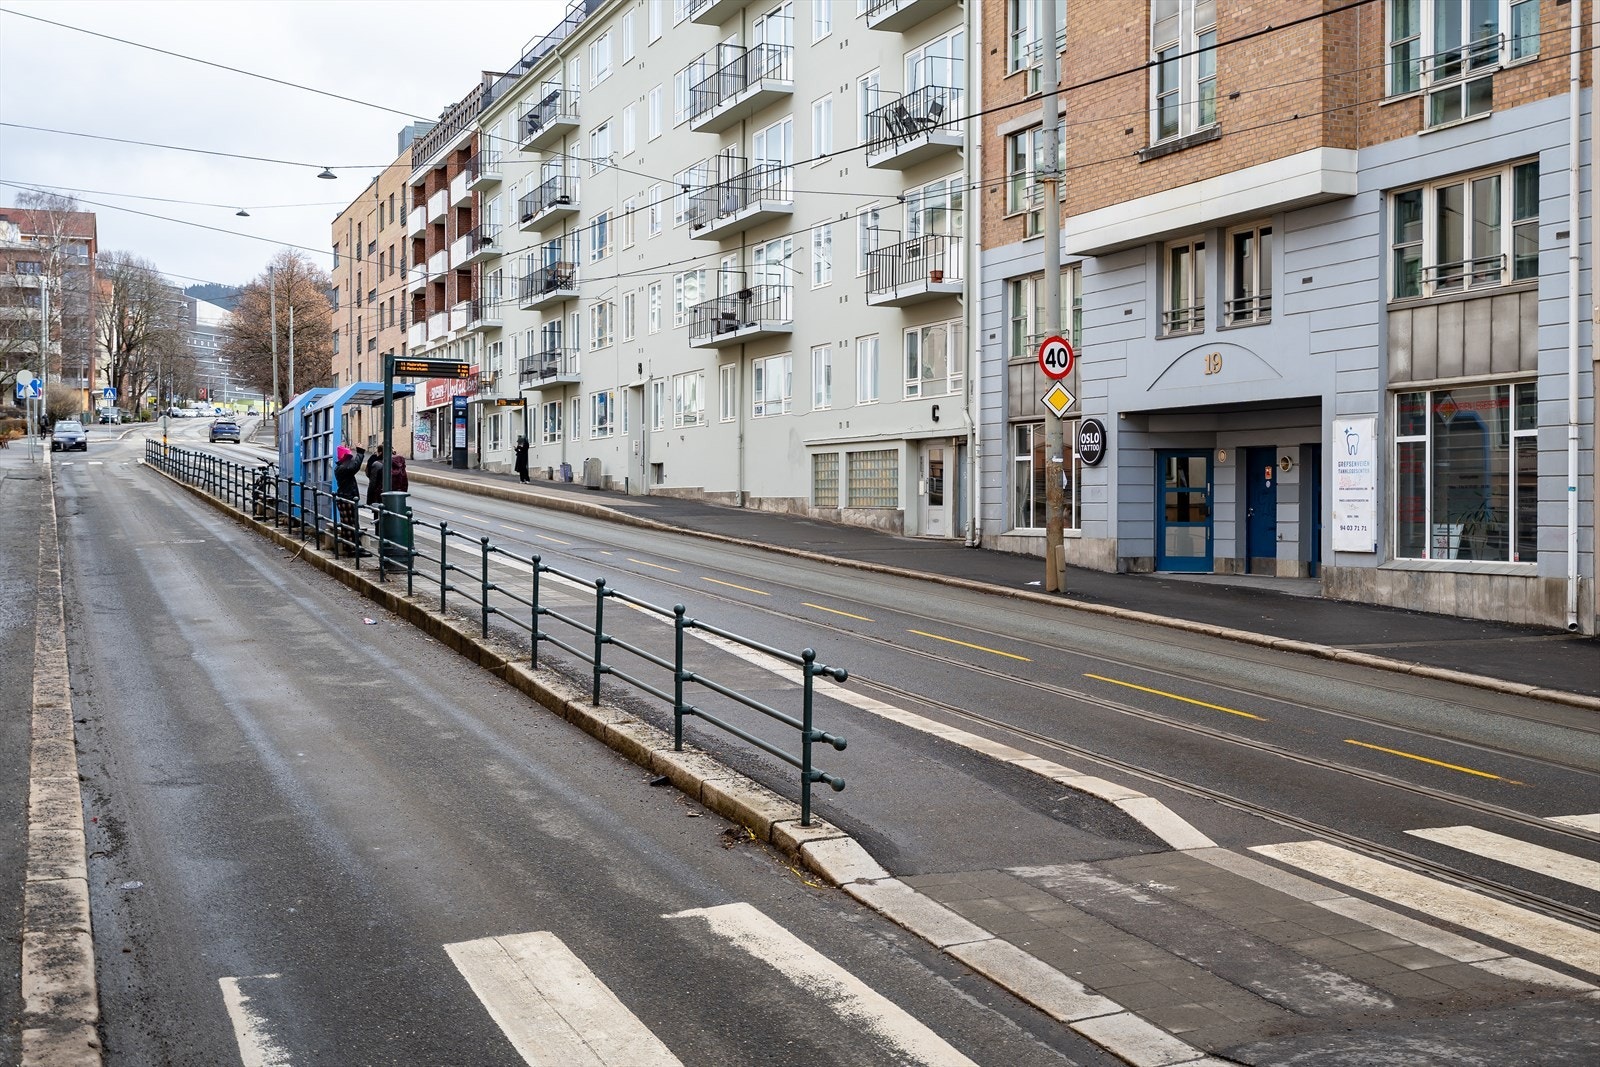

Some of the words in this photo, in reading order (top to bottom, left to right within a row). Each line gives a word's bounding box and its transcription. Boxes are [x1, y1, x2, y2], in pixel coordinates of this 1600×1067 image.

[1046, 348, 1068, 368] 40
[1204, 351, 1223, 375] 19
[932, 404, 940, 422] C
[1080, 432, 1100, 444] OSLO
